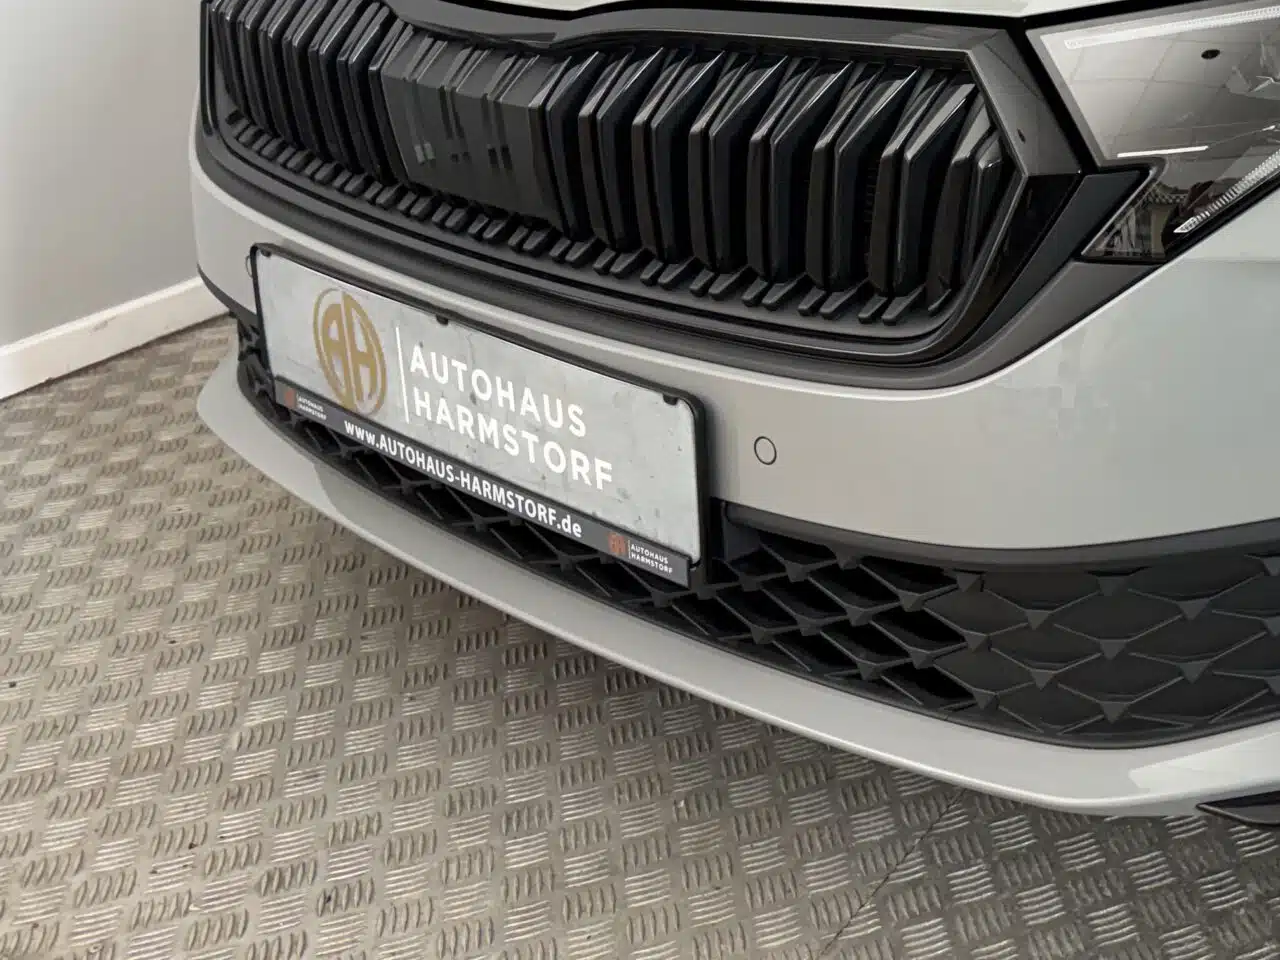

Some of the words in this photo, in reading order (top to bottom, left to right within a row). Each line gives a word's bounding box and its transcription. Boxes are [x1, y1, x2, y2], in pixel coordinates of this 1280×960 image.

[410, 345, 587, 437] AUTOHAUS
[344, 420, 582, 539] www.AUTOHAUS-HARMSTORF.de
[413, 388, 613, 491] HARMSTORF
[631, 544, 668, 564] AUTOHAUS
[631, 552, 672, 573] HARMSTORF
